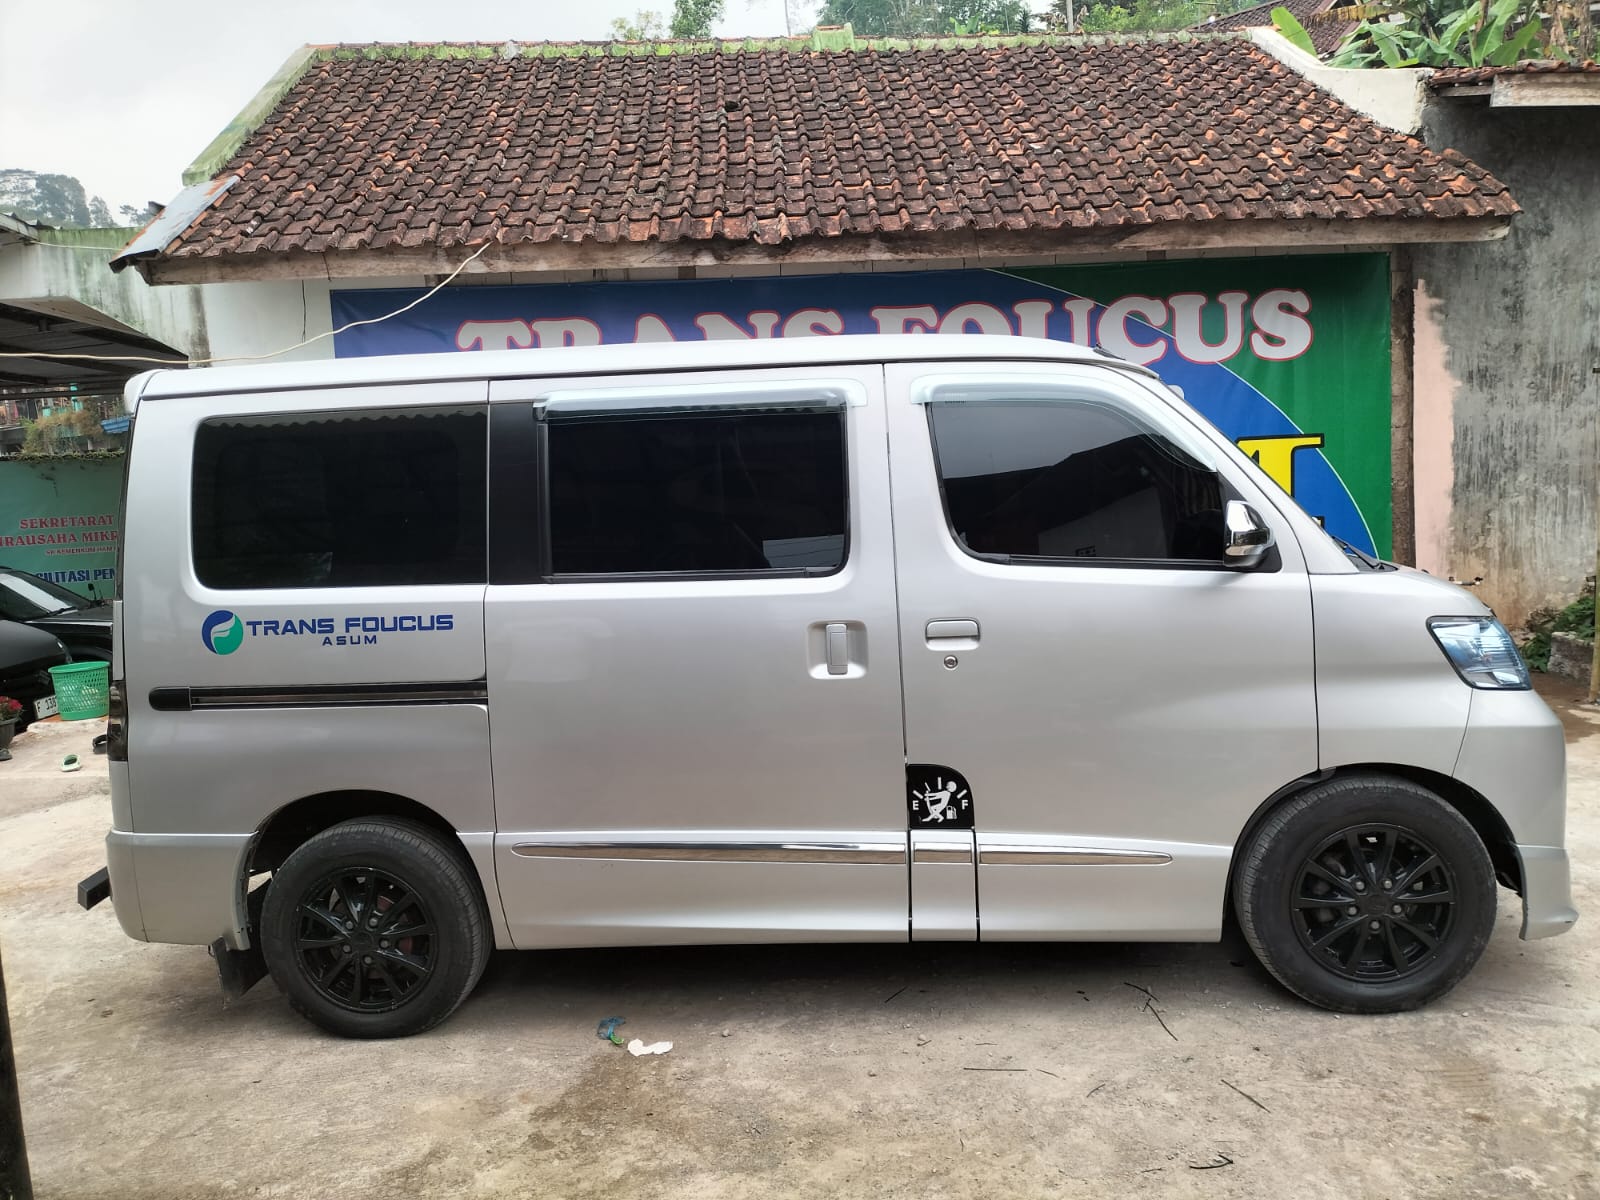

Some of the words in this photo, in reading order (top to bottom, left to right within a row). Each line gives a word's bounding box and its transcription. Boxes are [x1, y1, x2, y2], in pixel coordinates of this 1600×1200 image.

[246, 617, 334, 636] TRANS
[344, 614, 454, 634] FOUCUS
[322, 635, 377, 646] ASUM
[912, 800, 920, 811] E
[961, 799, 969, 810] F
